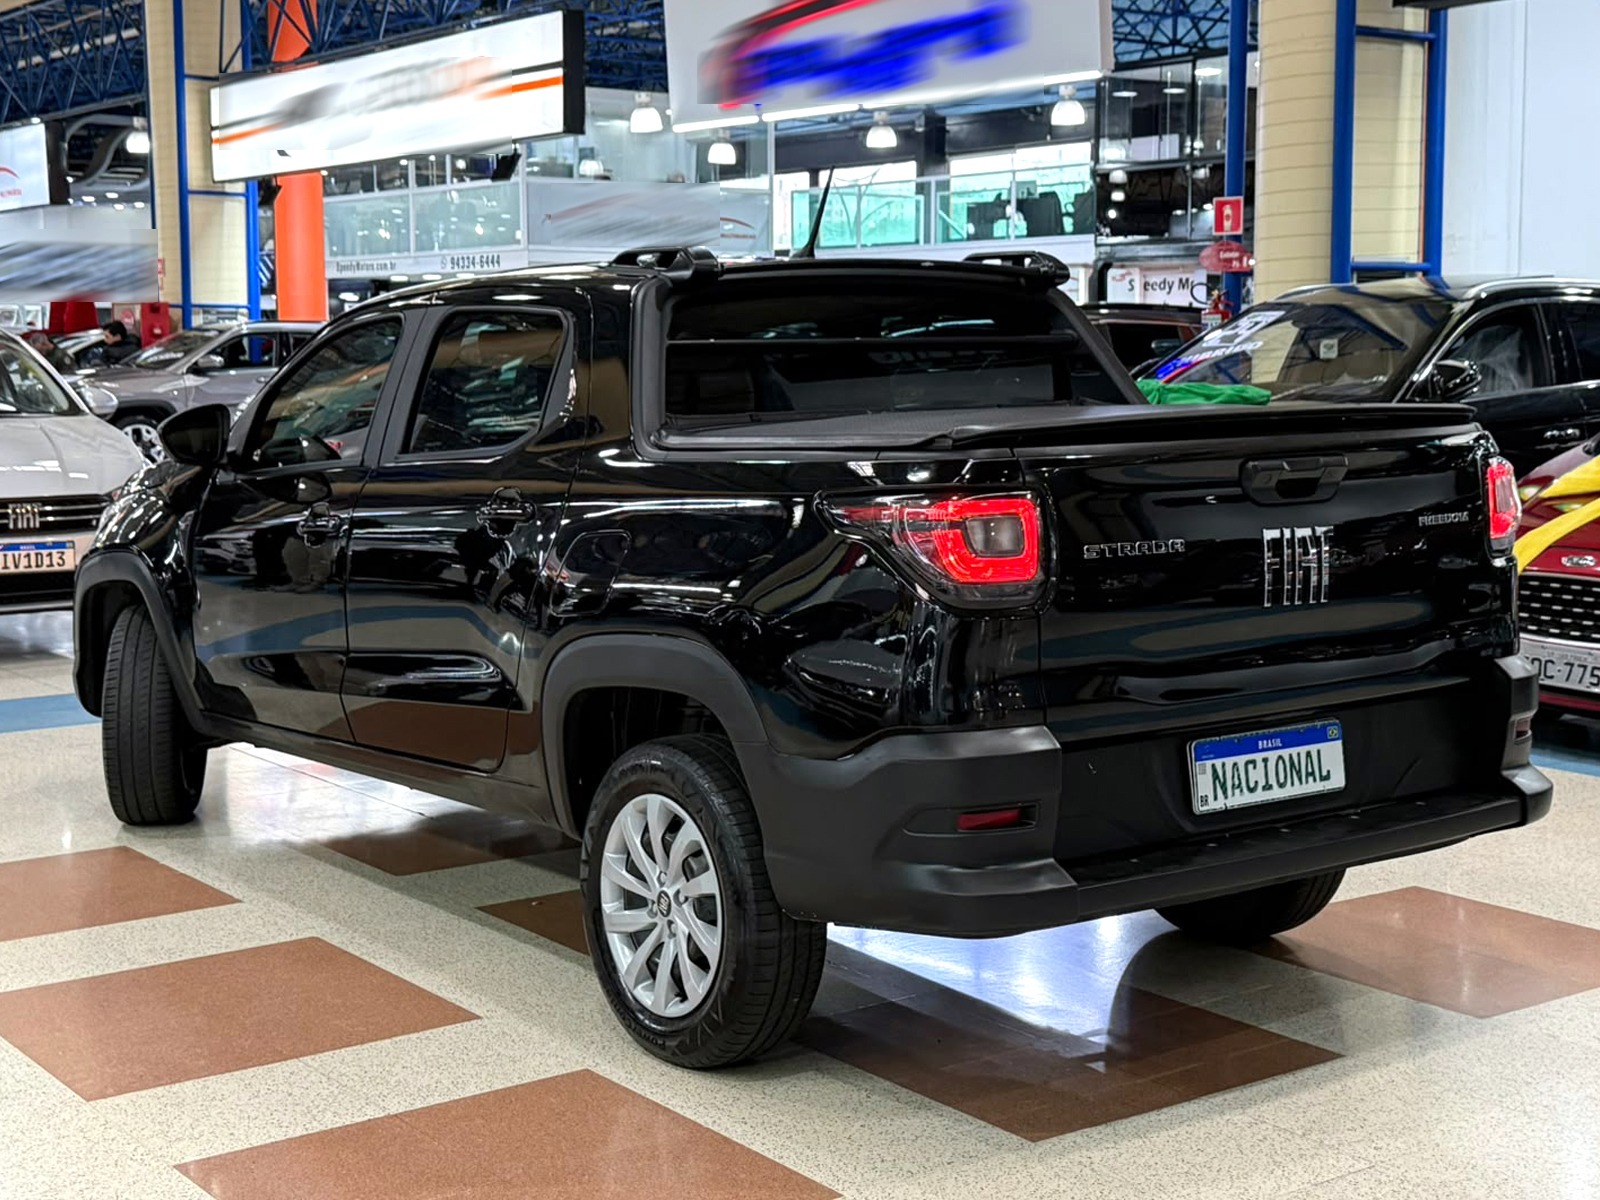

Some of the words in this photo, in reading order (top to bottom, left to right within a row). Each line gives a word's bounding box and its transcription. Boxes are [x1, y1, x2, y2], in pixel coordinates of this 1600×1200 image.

[450, 254, 501, 270] 94334-6444
[8, 502, 42, 529] FIAT
[1418, 511, 1469, 526] FREEDOM
[1083, 539, 1185, 559] STRADA
[1263, 525, 1334, 607] FIAT
[1258, 738, 1282, 750] BRASIL
[1211, 748, 1331, 802] NACIONAL
